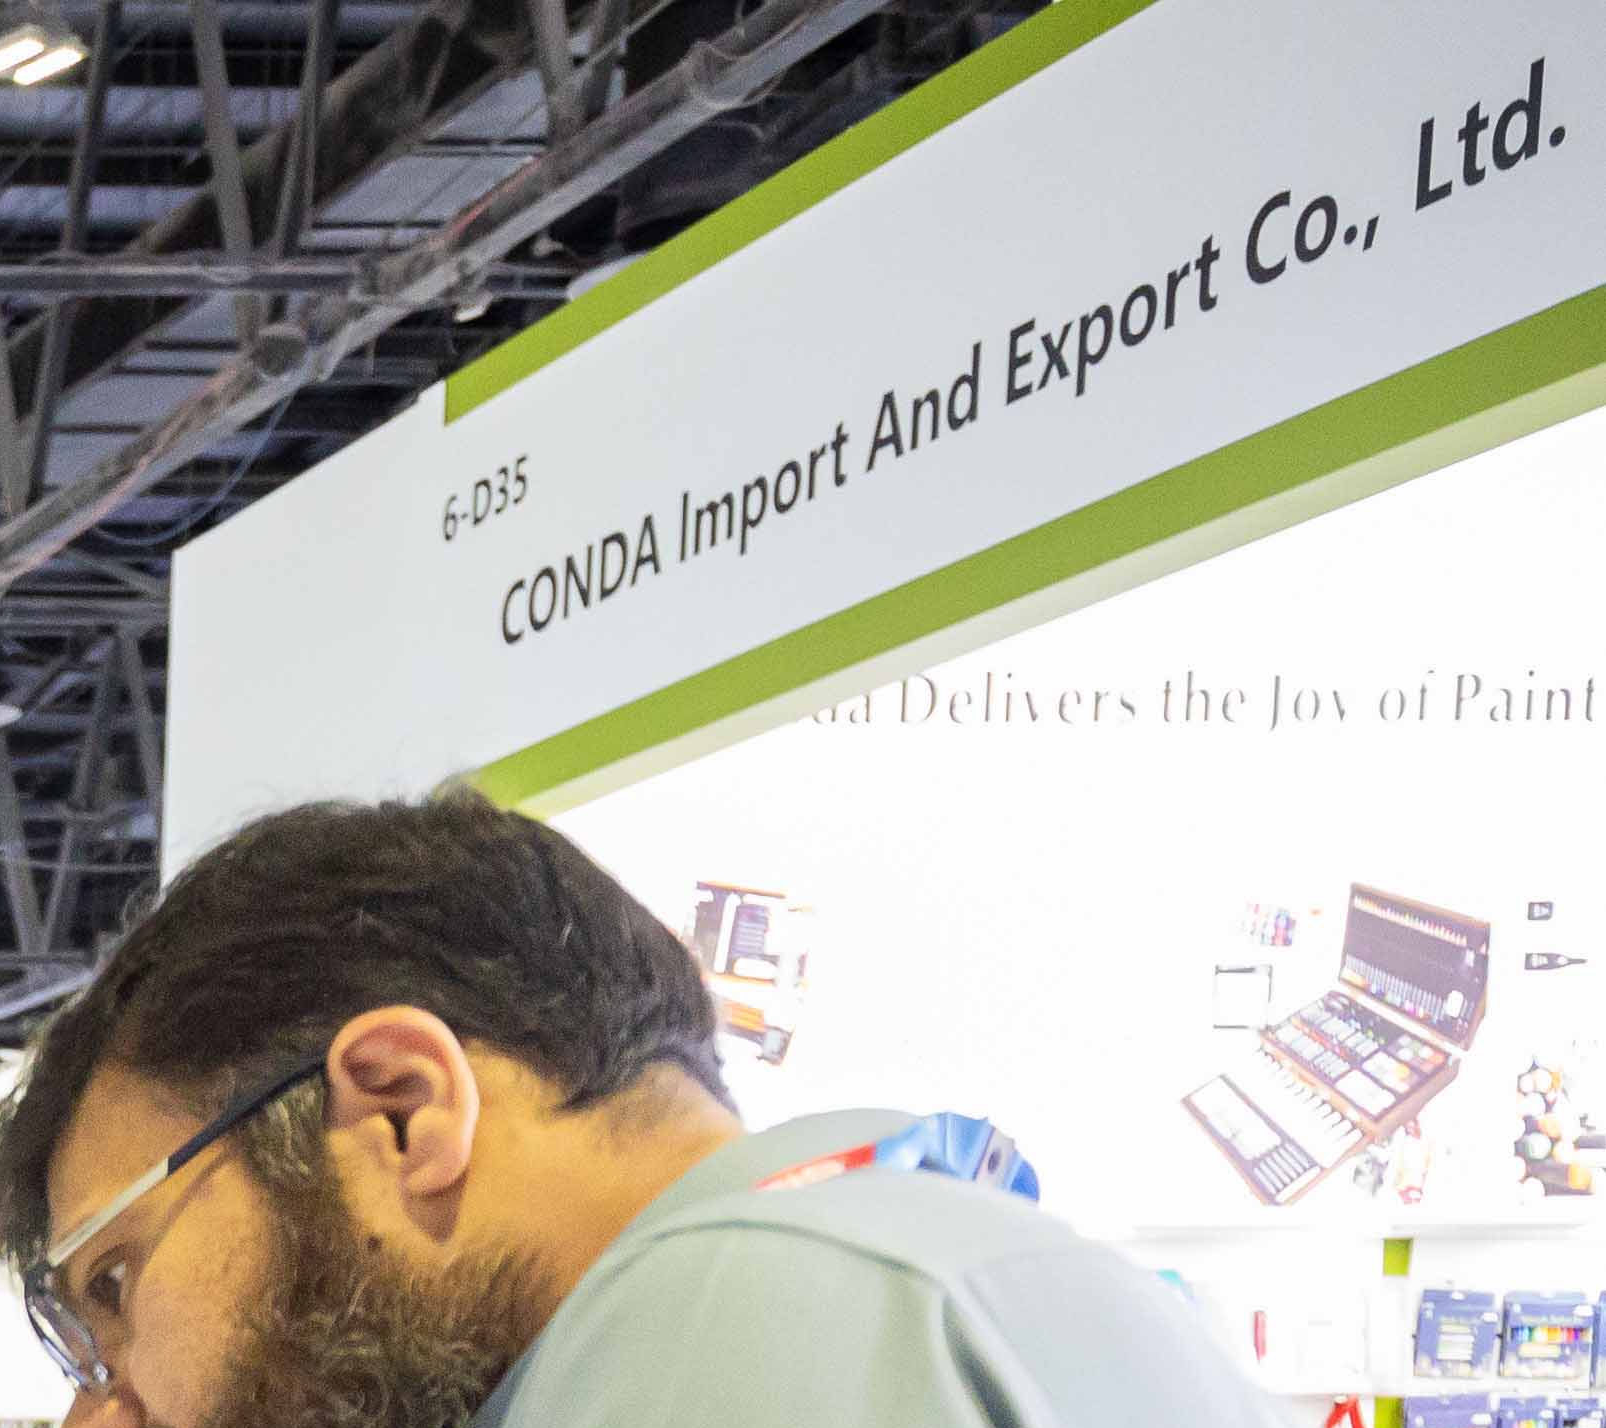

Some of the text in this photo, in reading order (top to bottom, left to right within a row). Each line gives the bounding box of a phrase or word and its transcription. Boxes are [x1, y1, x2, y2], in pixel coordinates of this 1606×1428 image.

[501, 58, 1567, 646] CONDA Import And Export Co., Ltd.
[442, 456, 530, 542] 6-D35
[899, 671, 1136, 725] Delivers
[1162, 670, 1246, 725] the
[1378, 669, 1438, 725] of
[1454, 670, 1600, 724] Paint
